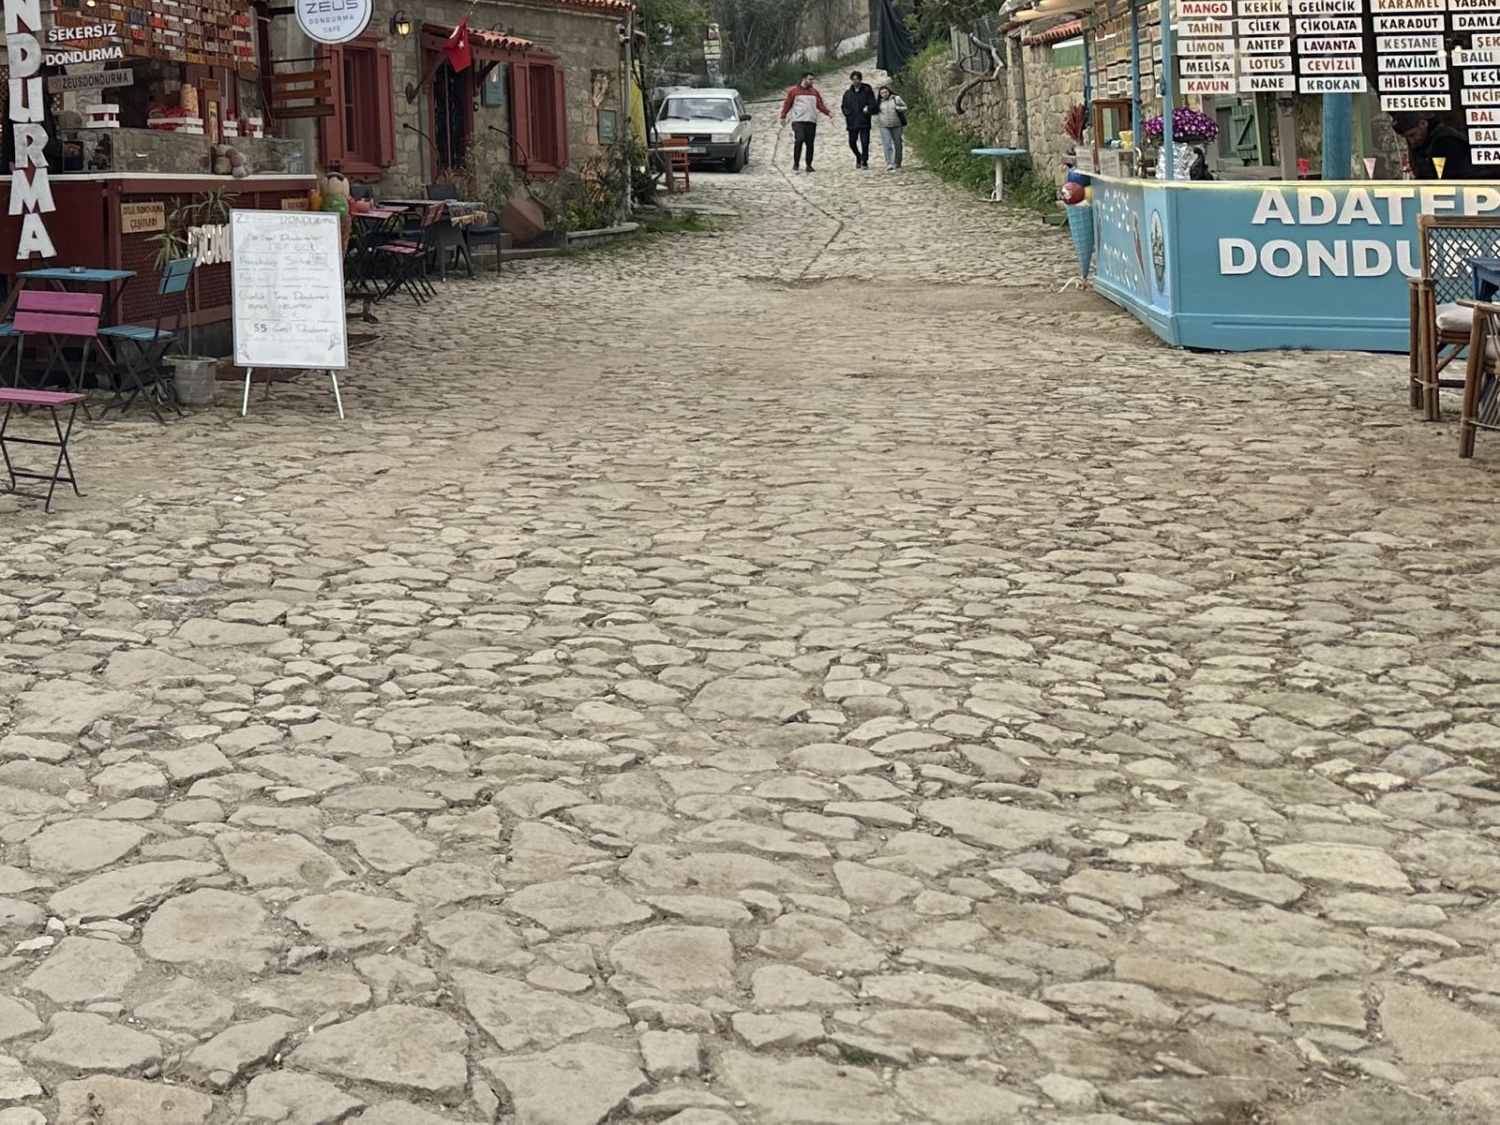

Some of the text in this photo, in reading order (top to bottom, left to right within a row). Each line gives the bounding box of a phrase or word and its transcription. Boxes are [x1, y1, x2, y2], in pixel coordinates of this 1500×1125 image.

[306, 0, 358, 14] ZEUS
[1182, 2, 1228, 14] MANGO
[1244, 1, 1282, 13] KEKİK
[309, 15, 354, 25] DONDURMA
[1248, 18, 1280, 32] ÇİLEK
[1301, 20, 1357, 32] ÇİKOLATA
[1380, 18, 1438, 29] KARADUT
[1187, 22, 1223, 33] TAHİN
[1186, 41, 1225, 52] LİMON
[1246, 40, 1284, 50] ANTEP
[1304, 39, 1356, 51] LAVANTA
[1384, 38, 1438, 49] KESTANE
[45, 46, 123, 66] DONDURMA
[1385, 55, 1440, 69] MAVİLİM
[1460, 51, 1493, 63] BALLI
[1186, 61, 1230, 72] MELİSA
[1250, 58, 1285, 69] LOTUS
[1307, 57, 1355, 71] CEVİZLİ
[62, 71, 128, 89] ZEUSDONDURMA
[1251, 77, 1284, 88] NANE
[1307, 78, 1360, 90] KROKAN
[1384, 75, 1445, 88] HİBİSKUS
[1187, 81, 1229, 92] KAVUN
[1387, 96, 1446, 109] FESLEĞEN
[1471, 111, 1494, 121] BAL
[1475, 130, 1498, 141] BAL
